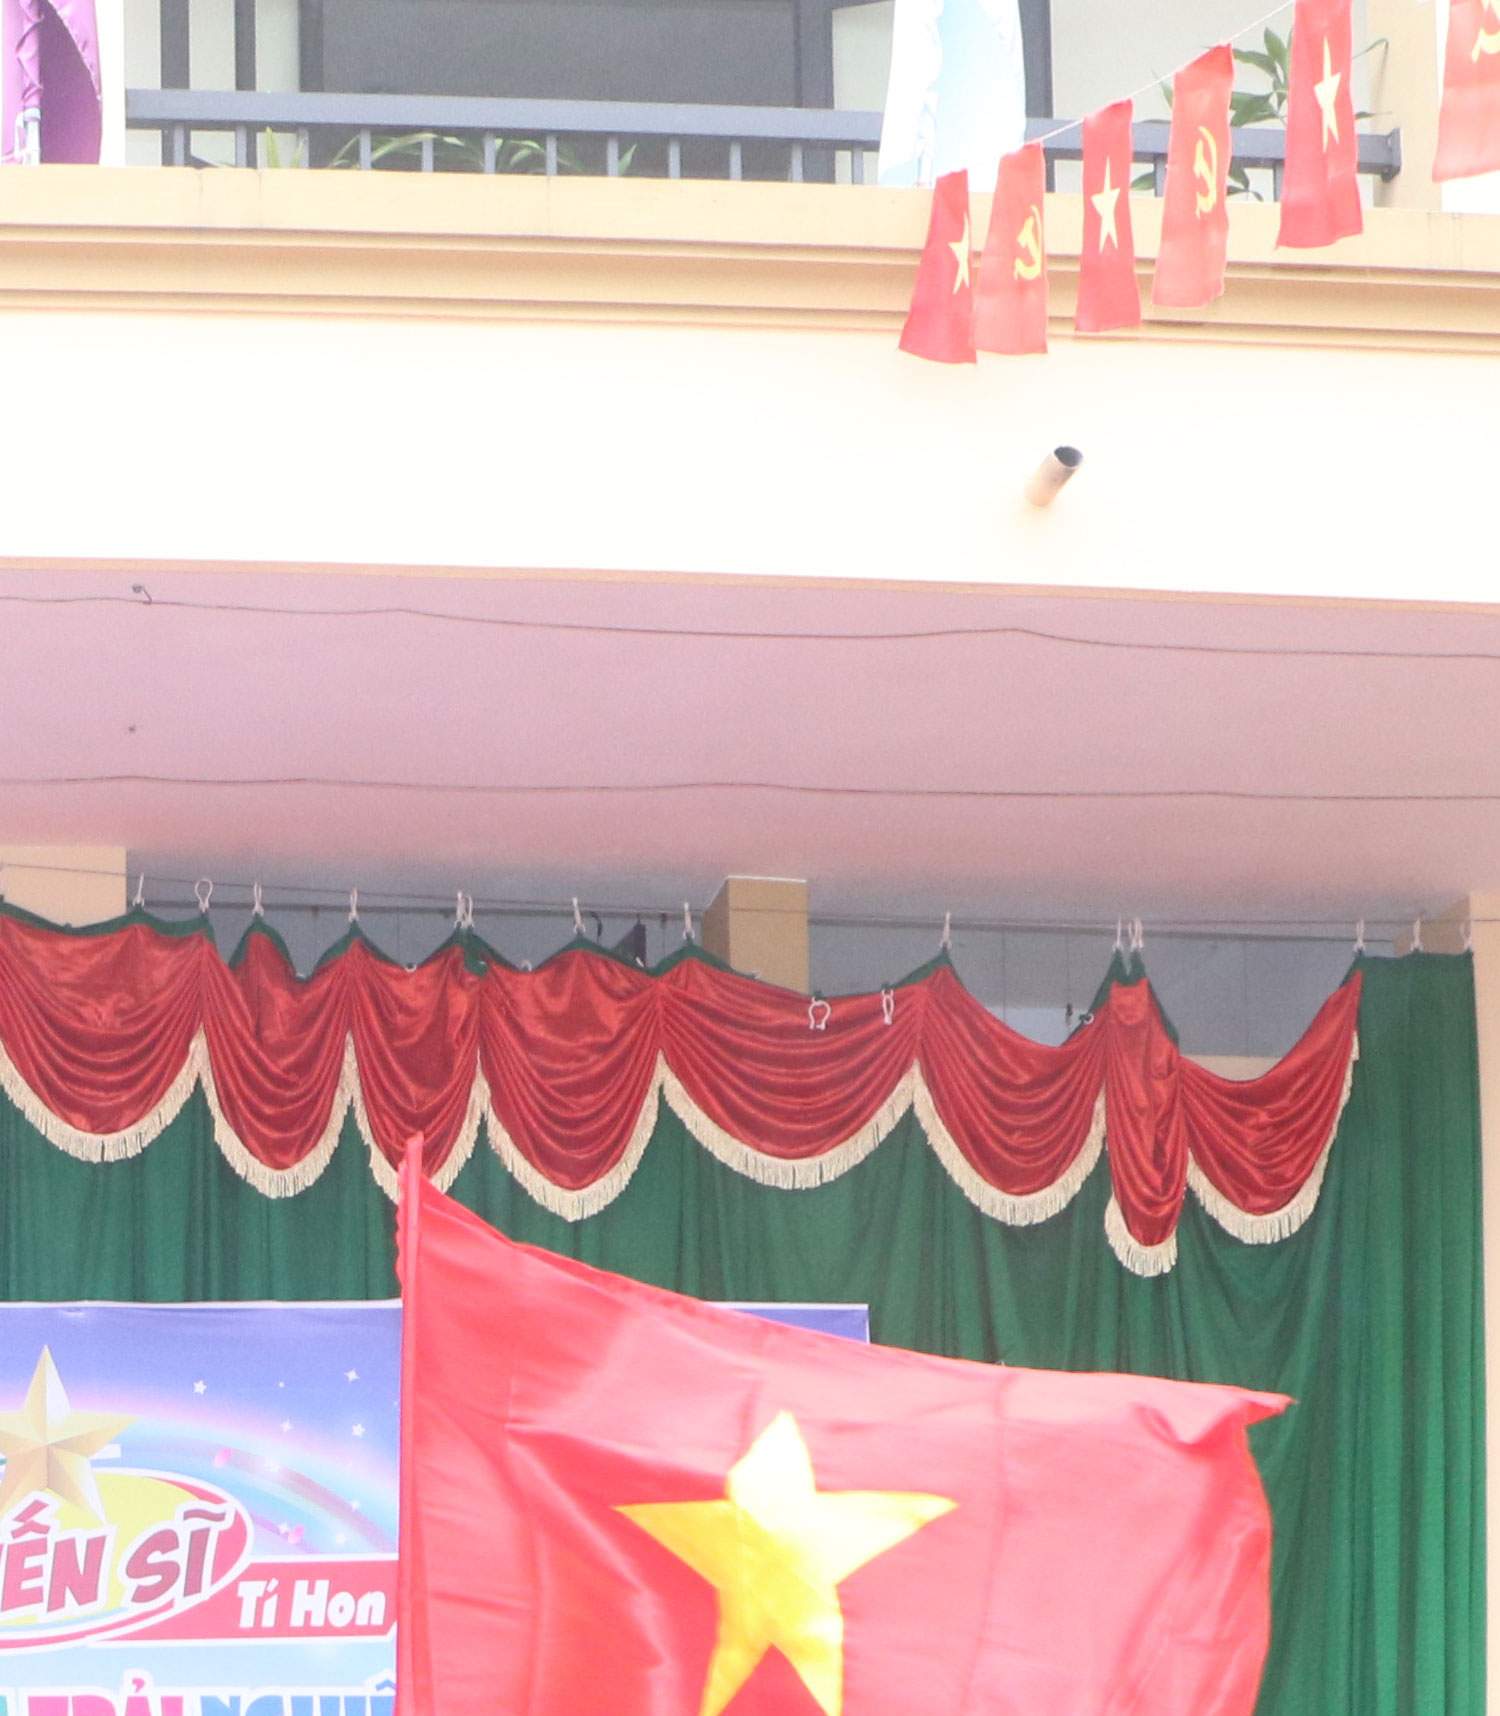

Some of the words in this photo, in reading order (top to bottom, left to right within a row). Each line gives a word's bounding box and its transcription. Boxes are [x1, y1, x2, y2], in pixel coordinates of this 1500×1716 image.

[125, 1508, 227, 1604] SĨ
[237, 1579, 277, 1628] Tí
[290, 1581, 386, 1627] Hon
